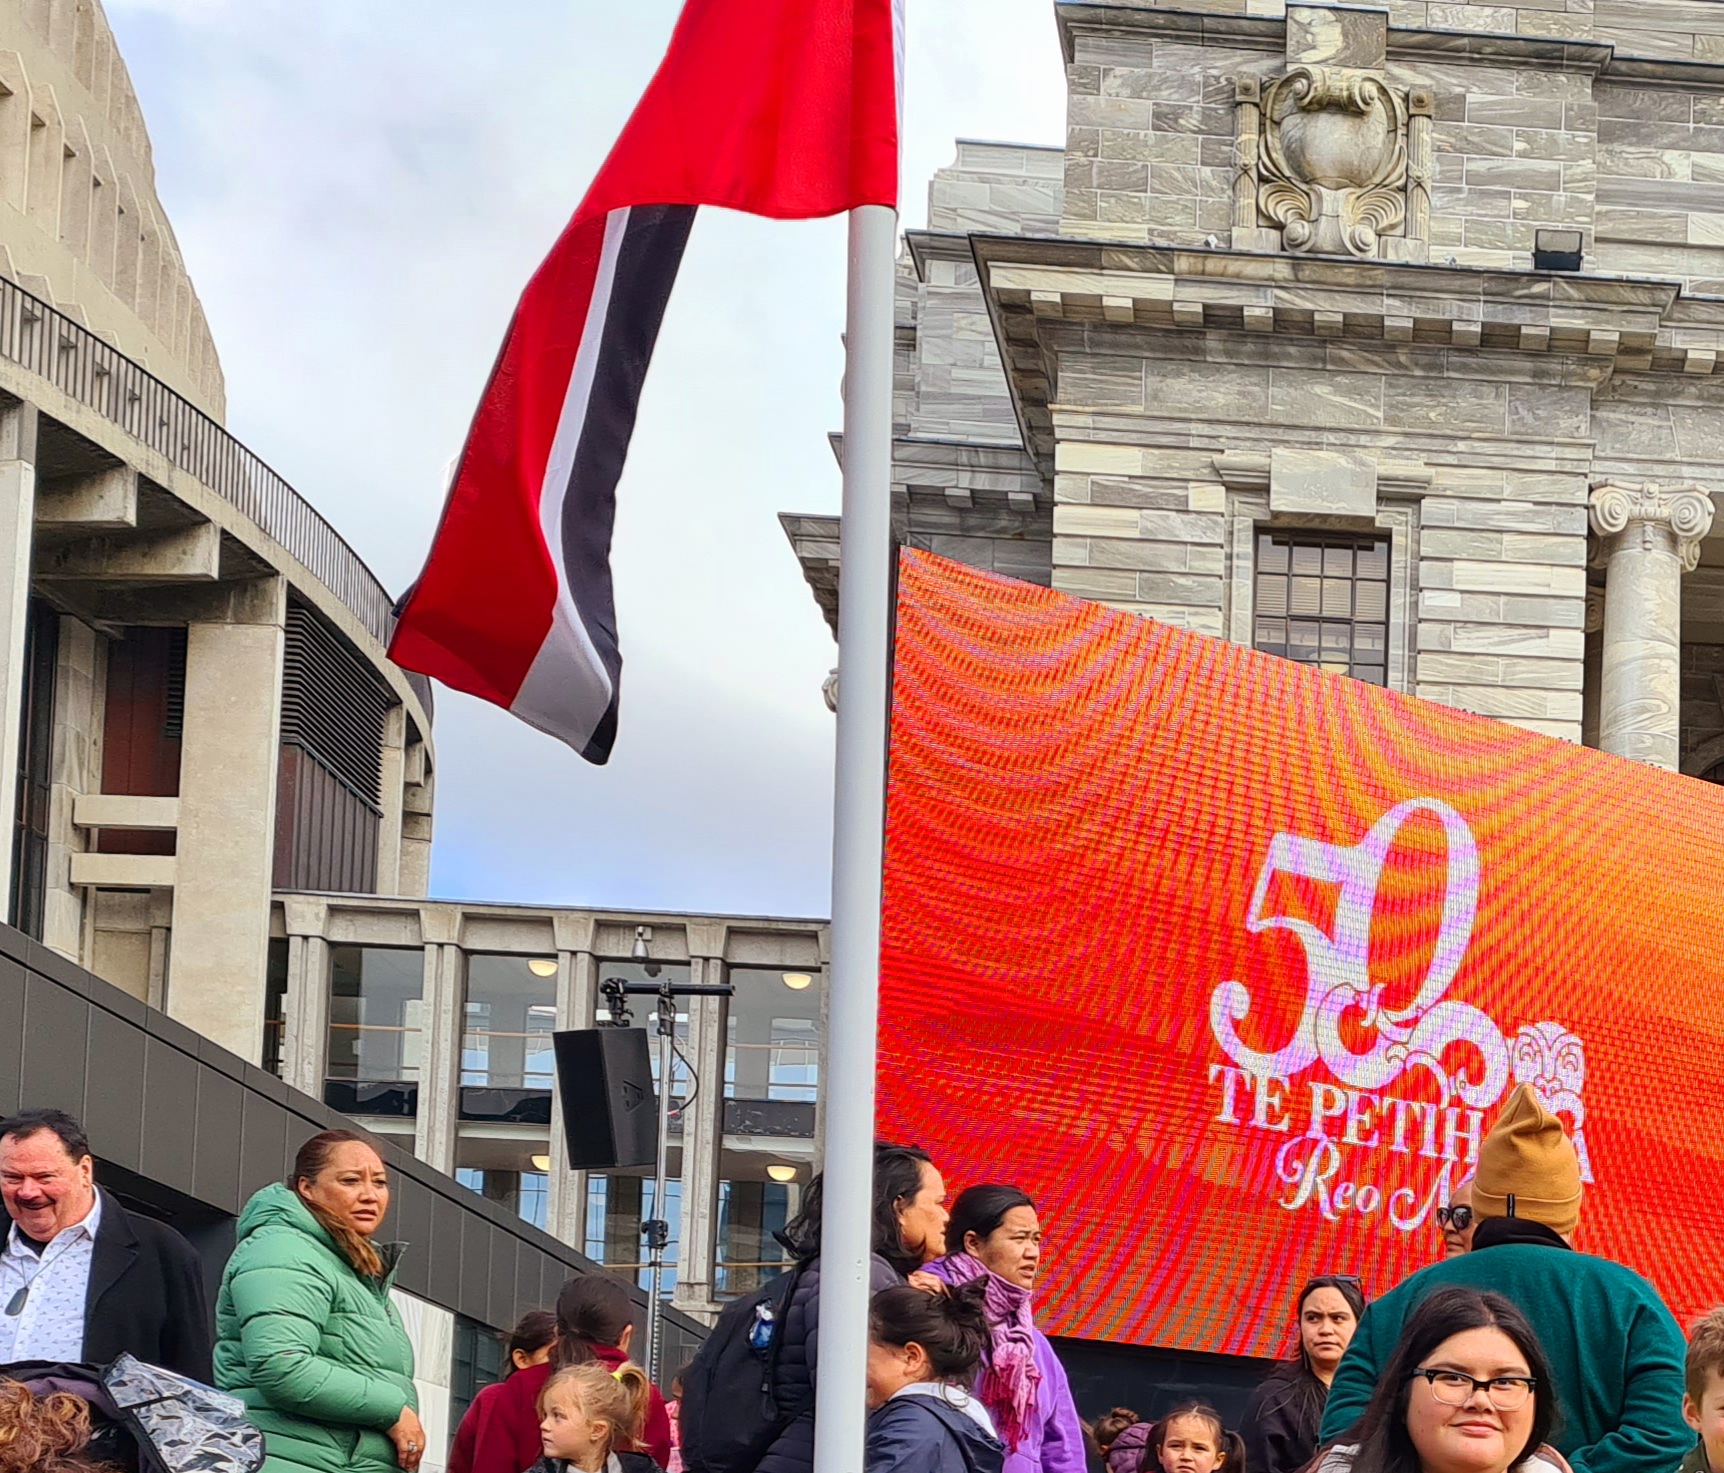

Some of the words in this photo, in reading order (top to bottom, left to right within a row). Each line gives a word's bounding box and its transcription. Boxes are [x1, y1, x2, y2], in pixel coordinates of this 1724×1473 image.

[1210, 796, 1480, 1077] 50
[1208, 1063, 1290, 1132] TE
[1275, 1134, 1381, 1221] Reo
